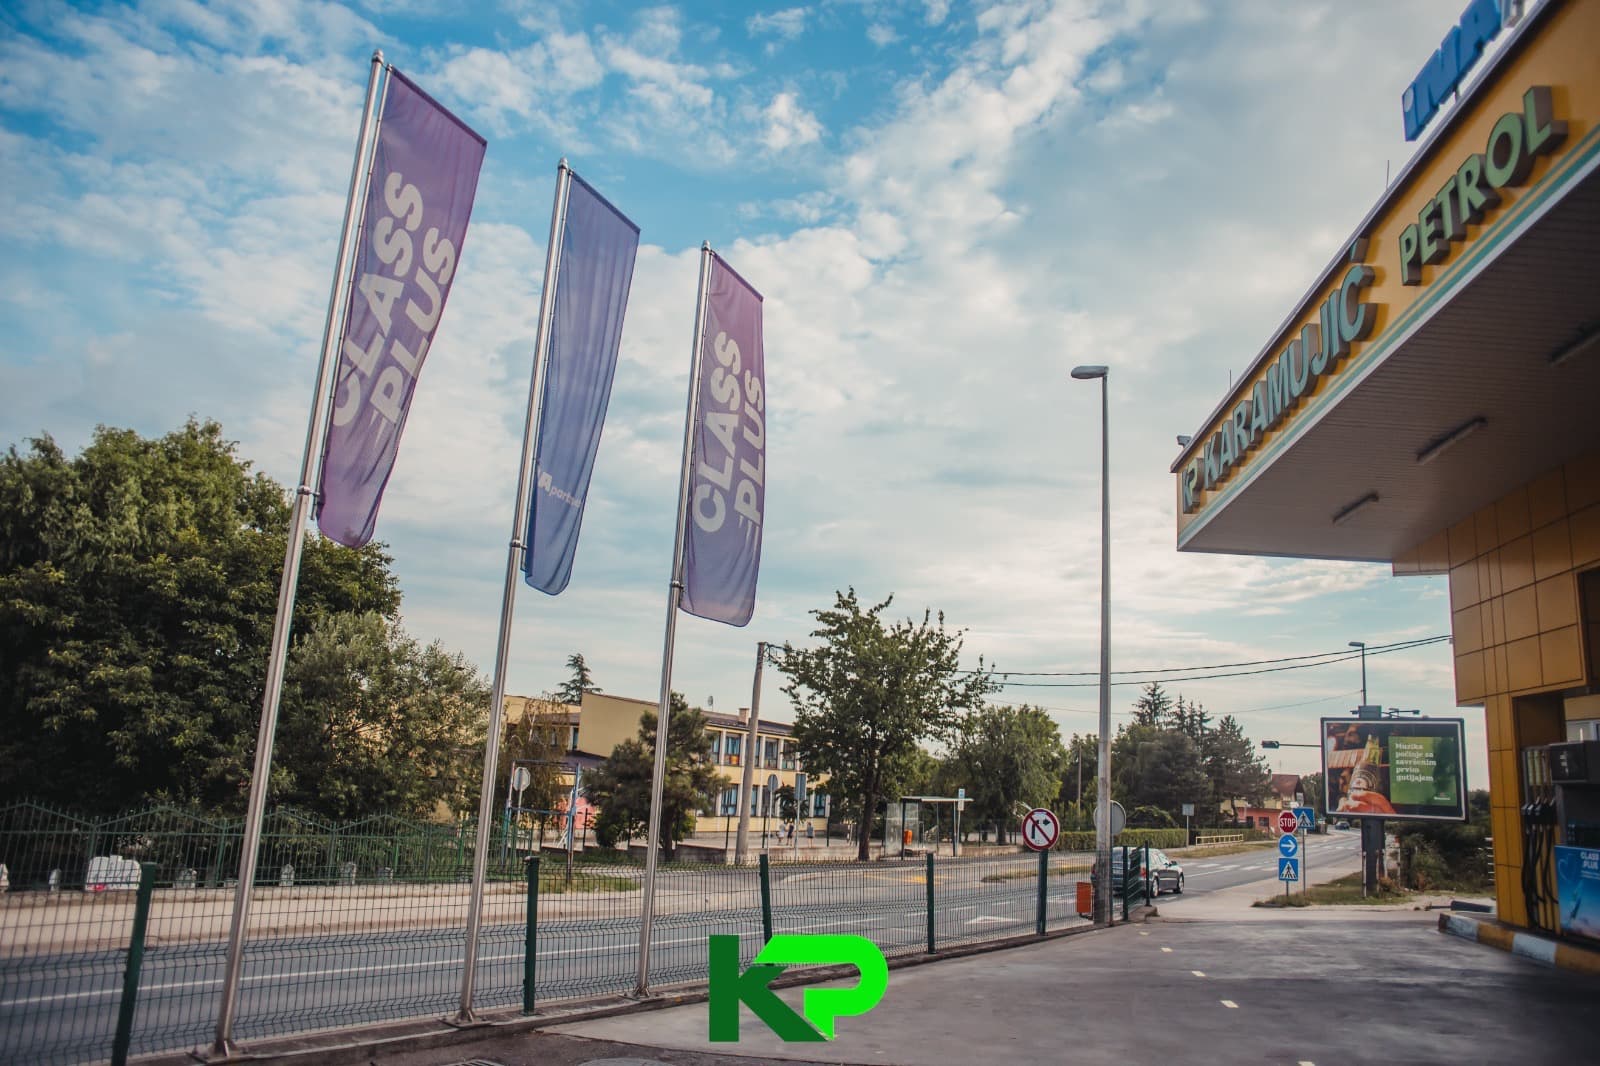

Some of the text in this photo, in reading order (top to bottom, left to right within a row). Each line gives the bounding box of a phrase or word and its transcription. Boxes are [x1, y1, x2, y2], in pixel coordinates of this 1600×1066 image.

[1399, 85, 1566, 286] PETROL
[332, 171, 424, 428] CLASS
[369, 227, 456, 425] PLUS
[692, 330, 742, 534] CLASS
[734, 369, 765, 527] PLUS
[1280, 817, 1296, 828] STOP
